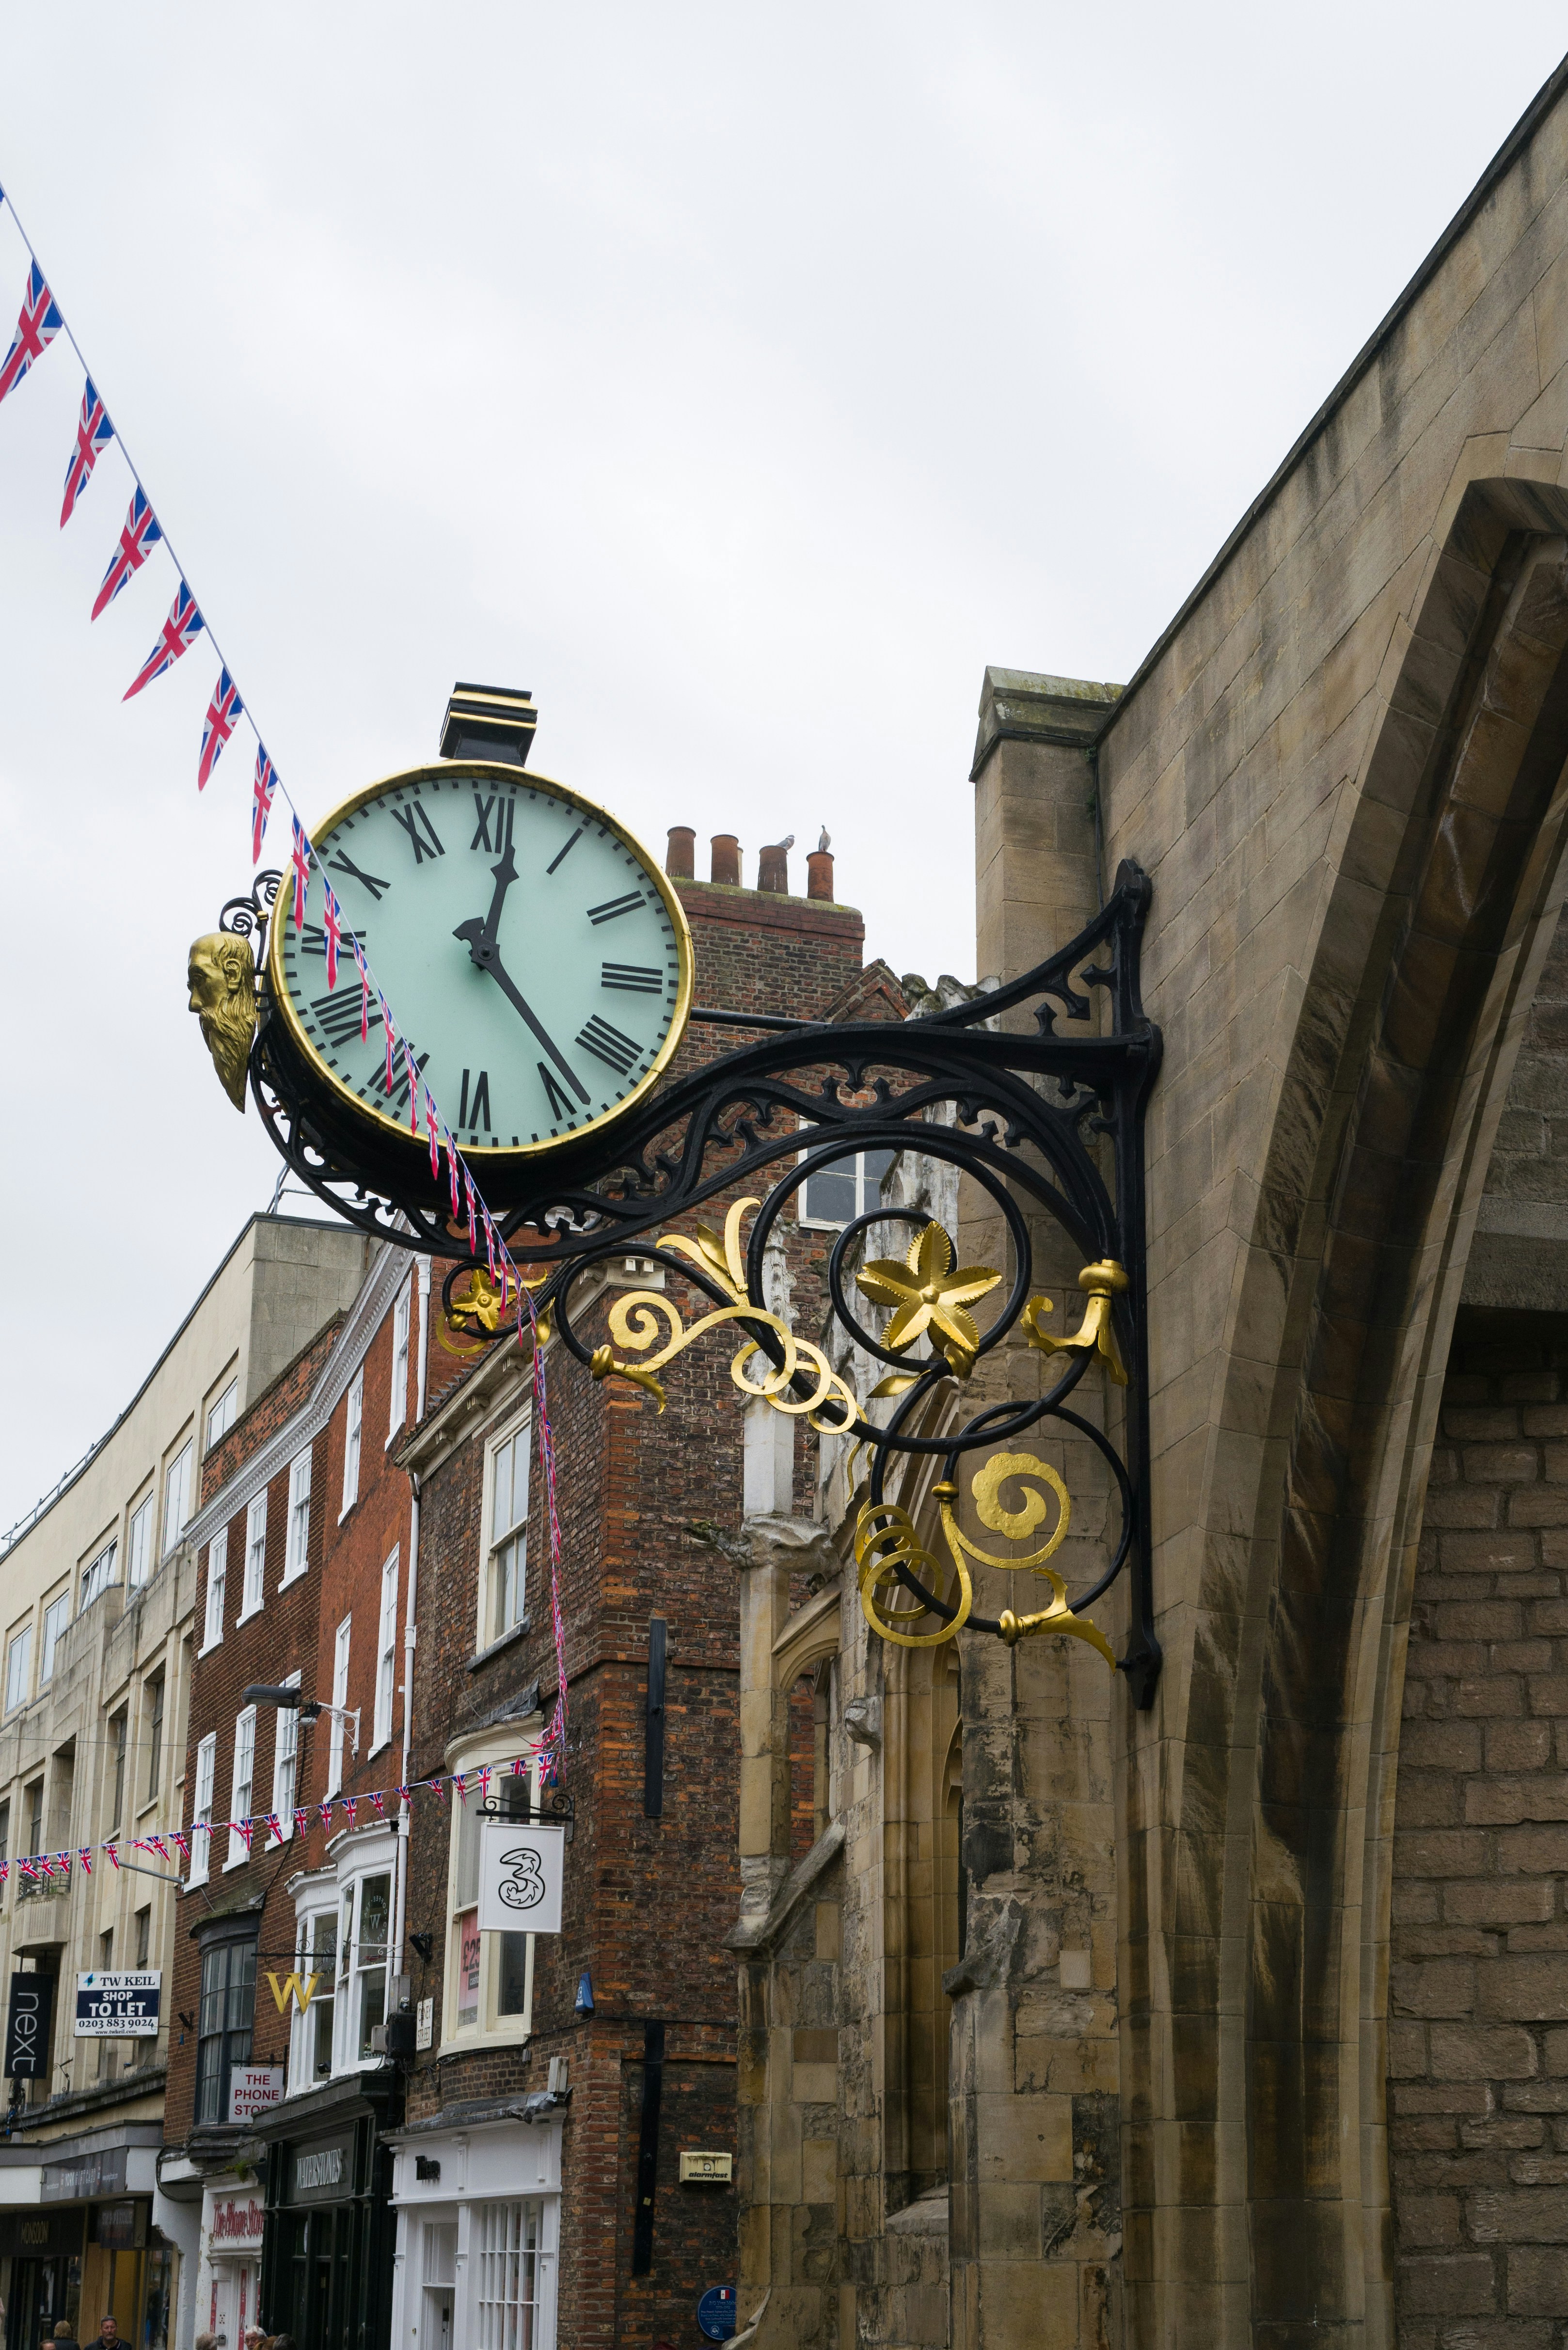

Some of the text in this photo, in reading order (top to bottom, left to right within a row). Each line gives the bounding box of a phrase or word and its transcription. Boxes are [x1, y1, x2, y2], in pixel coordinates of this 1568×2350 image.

[391, 800, 446, 864] XI
[470, 793, 515, 854] XII
[546, 827, 584, 875] I
[327, 849, 392, 901] X
[586, 890, 647, 926] II
[601, 962, 663, 994] III
[574, 1014, 645, 1077] IIII
[459, 1068, 491, 1132] VI
[537, 1062, 578, 1121] V
[498, 1847, 546, 1909] 3
[100, 1976, 156, 1986] TW KEIL
[103, 1991, 133, 2001] SHOP
[262, 1972, 324, 2015] W
[79, 2019, 154, 2029] 0203 883 9024
[89, 2002, 146, 2017] TO LET
[418, 2004, 432, 2021] CNEY
[12, 1992, 39, 2072] next
[235, 2089, 279, 2100] PHONE
[246, 2074, 270, 2085] THE
[297, 2148, 342, 2189] WATERSTONES
[21, 2221, 48, 2245] MONSOON
